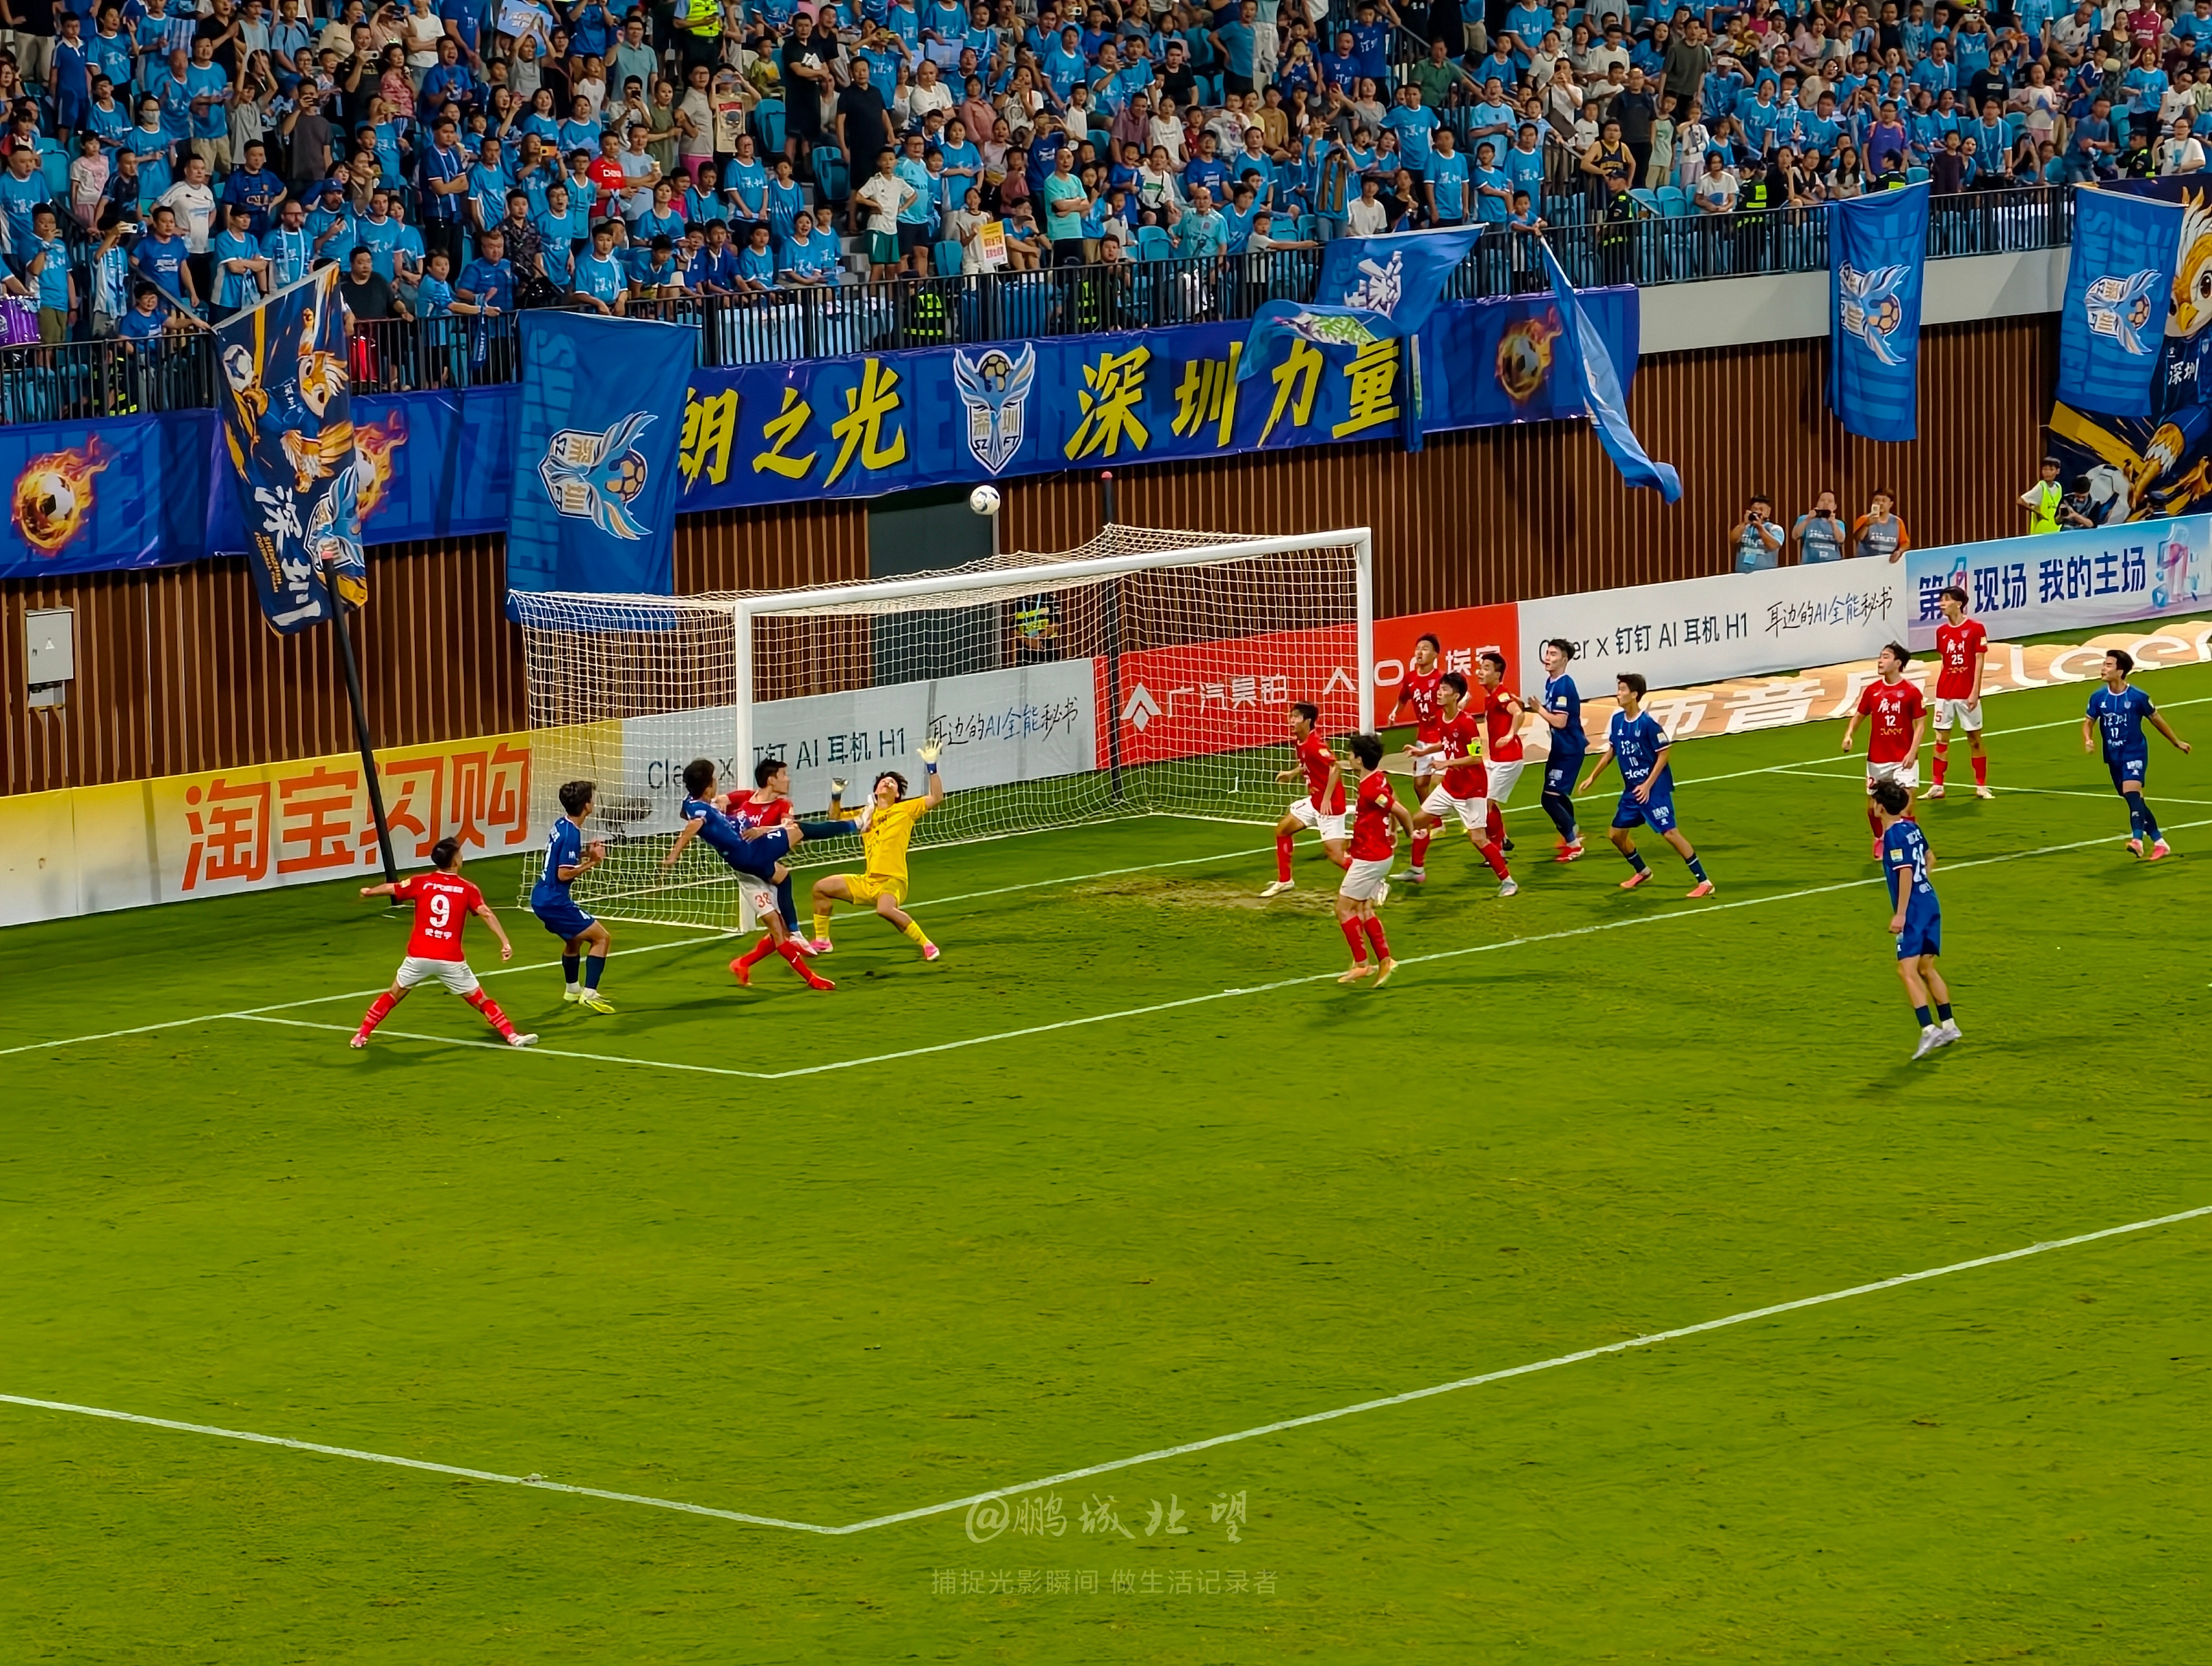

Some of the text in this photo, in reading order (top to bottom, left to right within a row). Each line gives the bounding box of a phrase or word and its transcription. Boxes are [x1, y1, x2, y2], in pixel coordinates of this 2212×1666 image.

[2168, 358, 2200, 386] 深圳
[975, 435, 1019, 450] SZ FT
[2039, 546, 2146, 604] 我的主场
[1765, 586, 1893, 639] 耳边的AI全能秘书
[1615, 624, 1651, 655] 钉钉
[1658, 622, 1677, 649] AI
[1684, 616, 1720, 645] 耳机
[1726, 612, 1747, 639] H1
[1952, 654, 1964, 665] 25
[1885, 715, 1896, 726] 12
[796, 739, 819, 770] AI
[827, 732, 871, 764] 耳机
[880, 727, 905, 757] H1
[1629, 757, 1638, 767] 10
[182, 742, 531, 891] 淘宝闪购
[429, 894, 449, 927] 9
